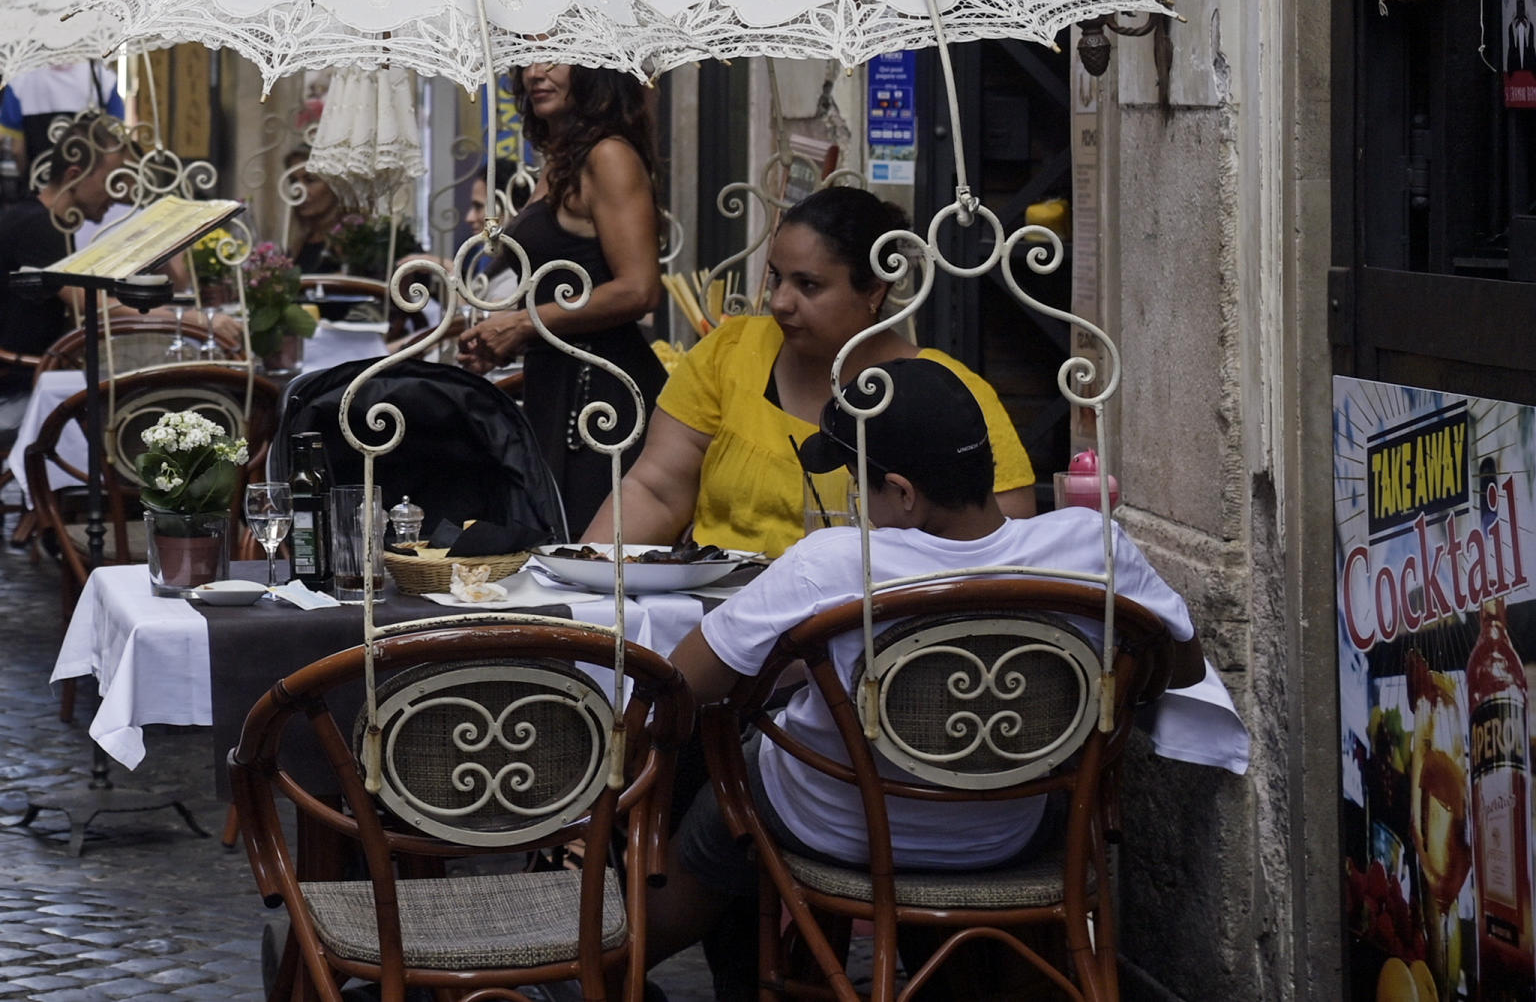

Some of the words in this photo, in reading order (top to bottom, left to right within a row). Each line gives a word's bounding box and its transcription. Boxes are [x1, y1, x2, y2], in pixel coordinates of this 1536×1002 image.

[1372, 442, 1413, 519] TAKE
[1414, 422, 1465, 508] AWAY
[1343, 474, 1529, 652] Cocktail
[1470, 712, 1524, 767] APEROL
